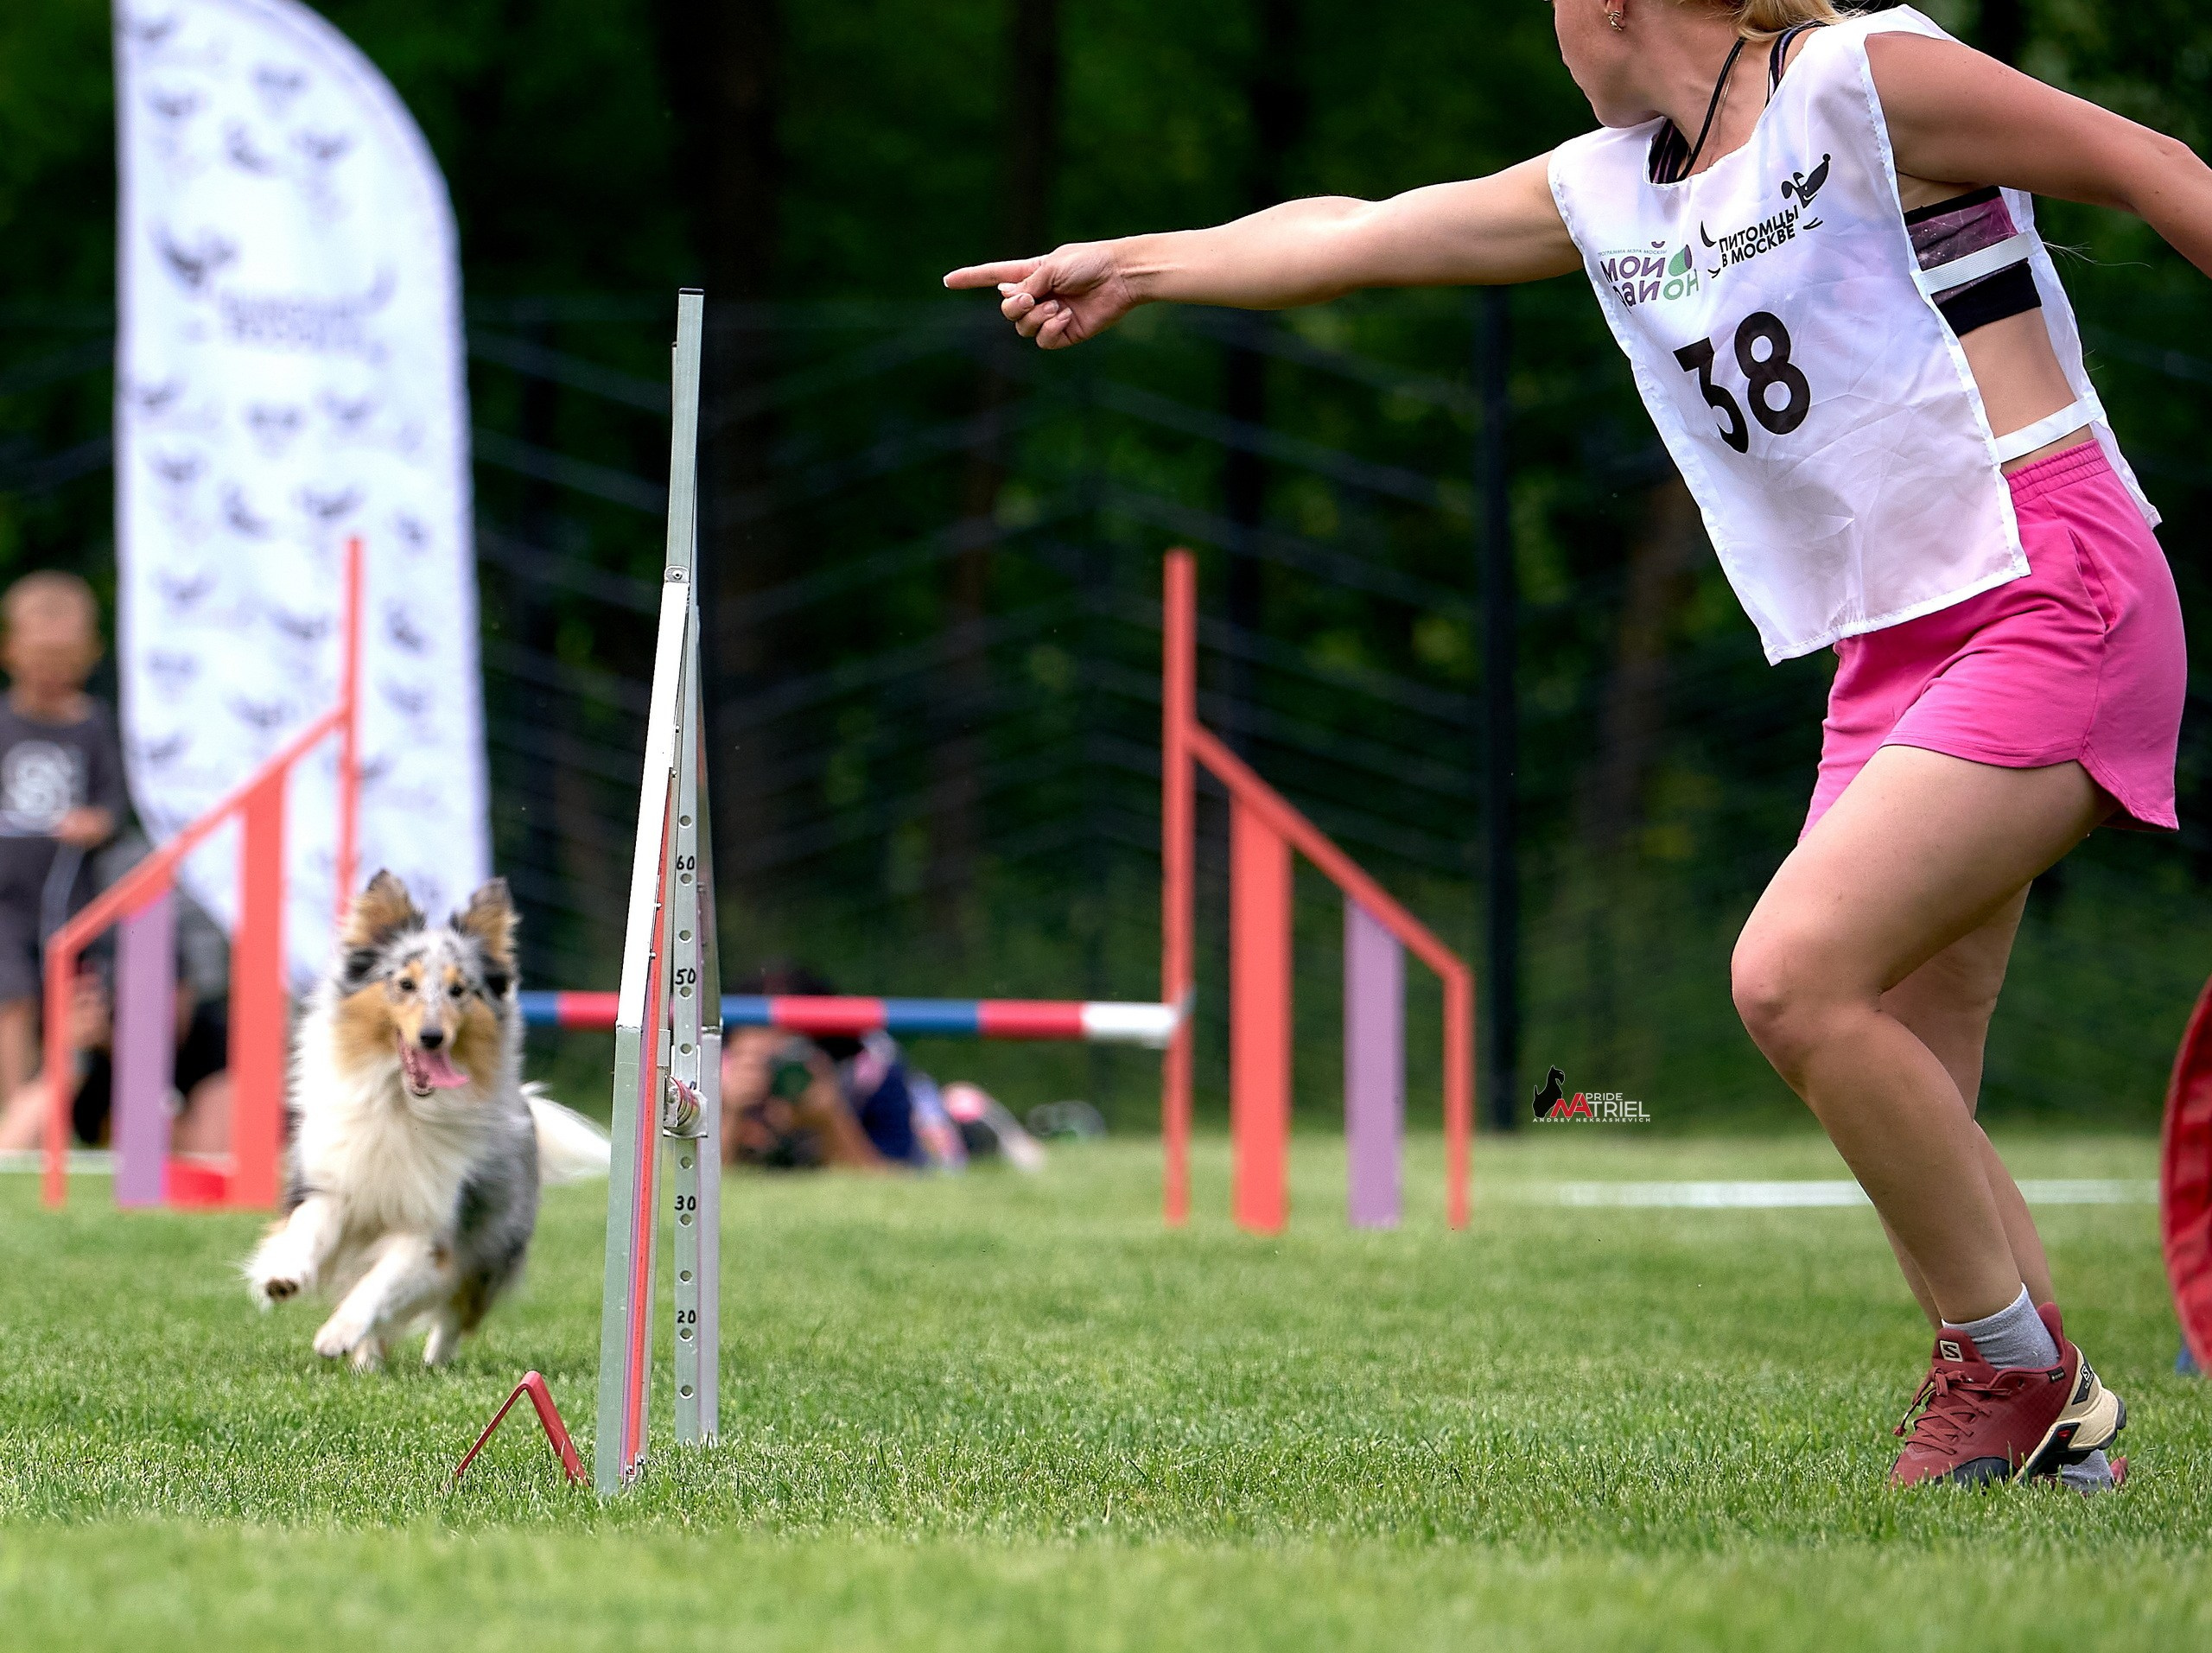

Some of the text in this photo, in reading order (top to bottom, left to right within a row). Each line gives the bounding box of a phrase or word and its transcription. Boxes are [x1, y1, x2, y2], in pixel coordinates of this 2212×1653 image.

[1719, 204, 1799, 253] ПИТОМЦЫ
[1721, 222, 1796, 268] В МОСКВЕ
[1673, 310, 1811, 455] 38
[677, 855, 696, 870] 60
[675, 968, 696, 985] 50
[674, 1195, 696, 1211] 30
[677, 1309, 696, 1324] 20
